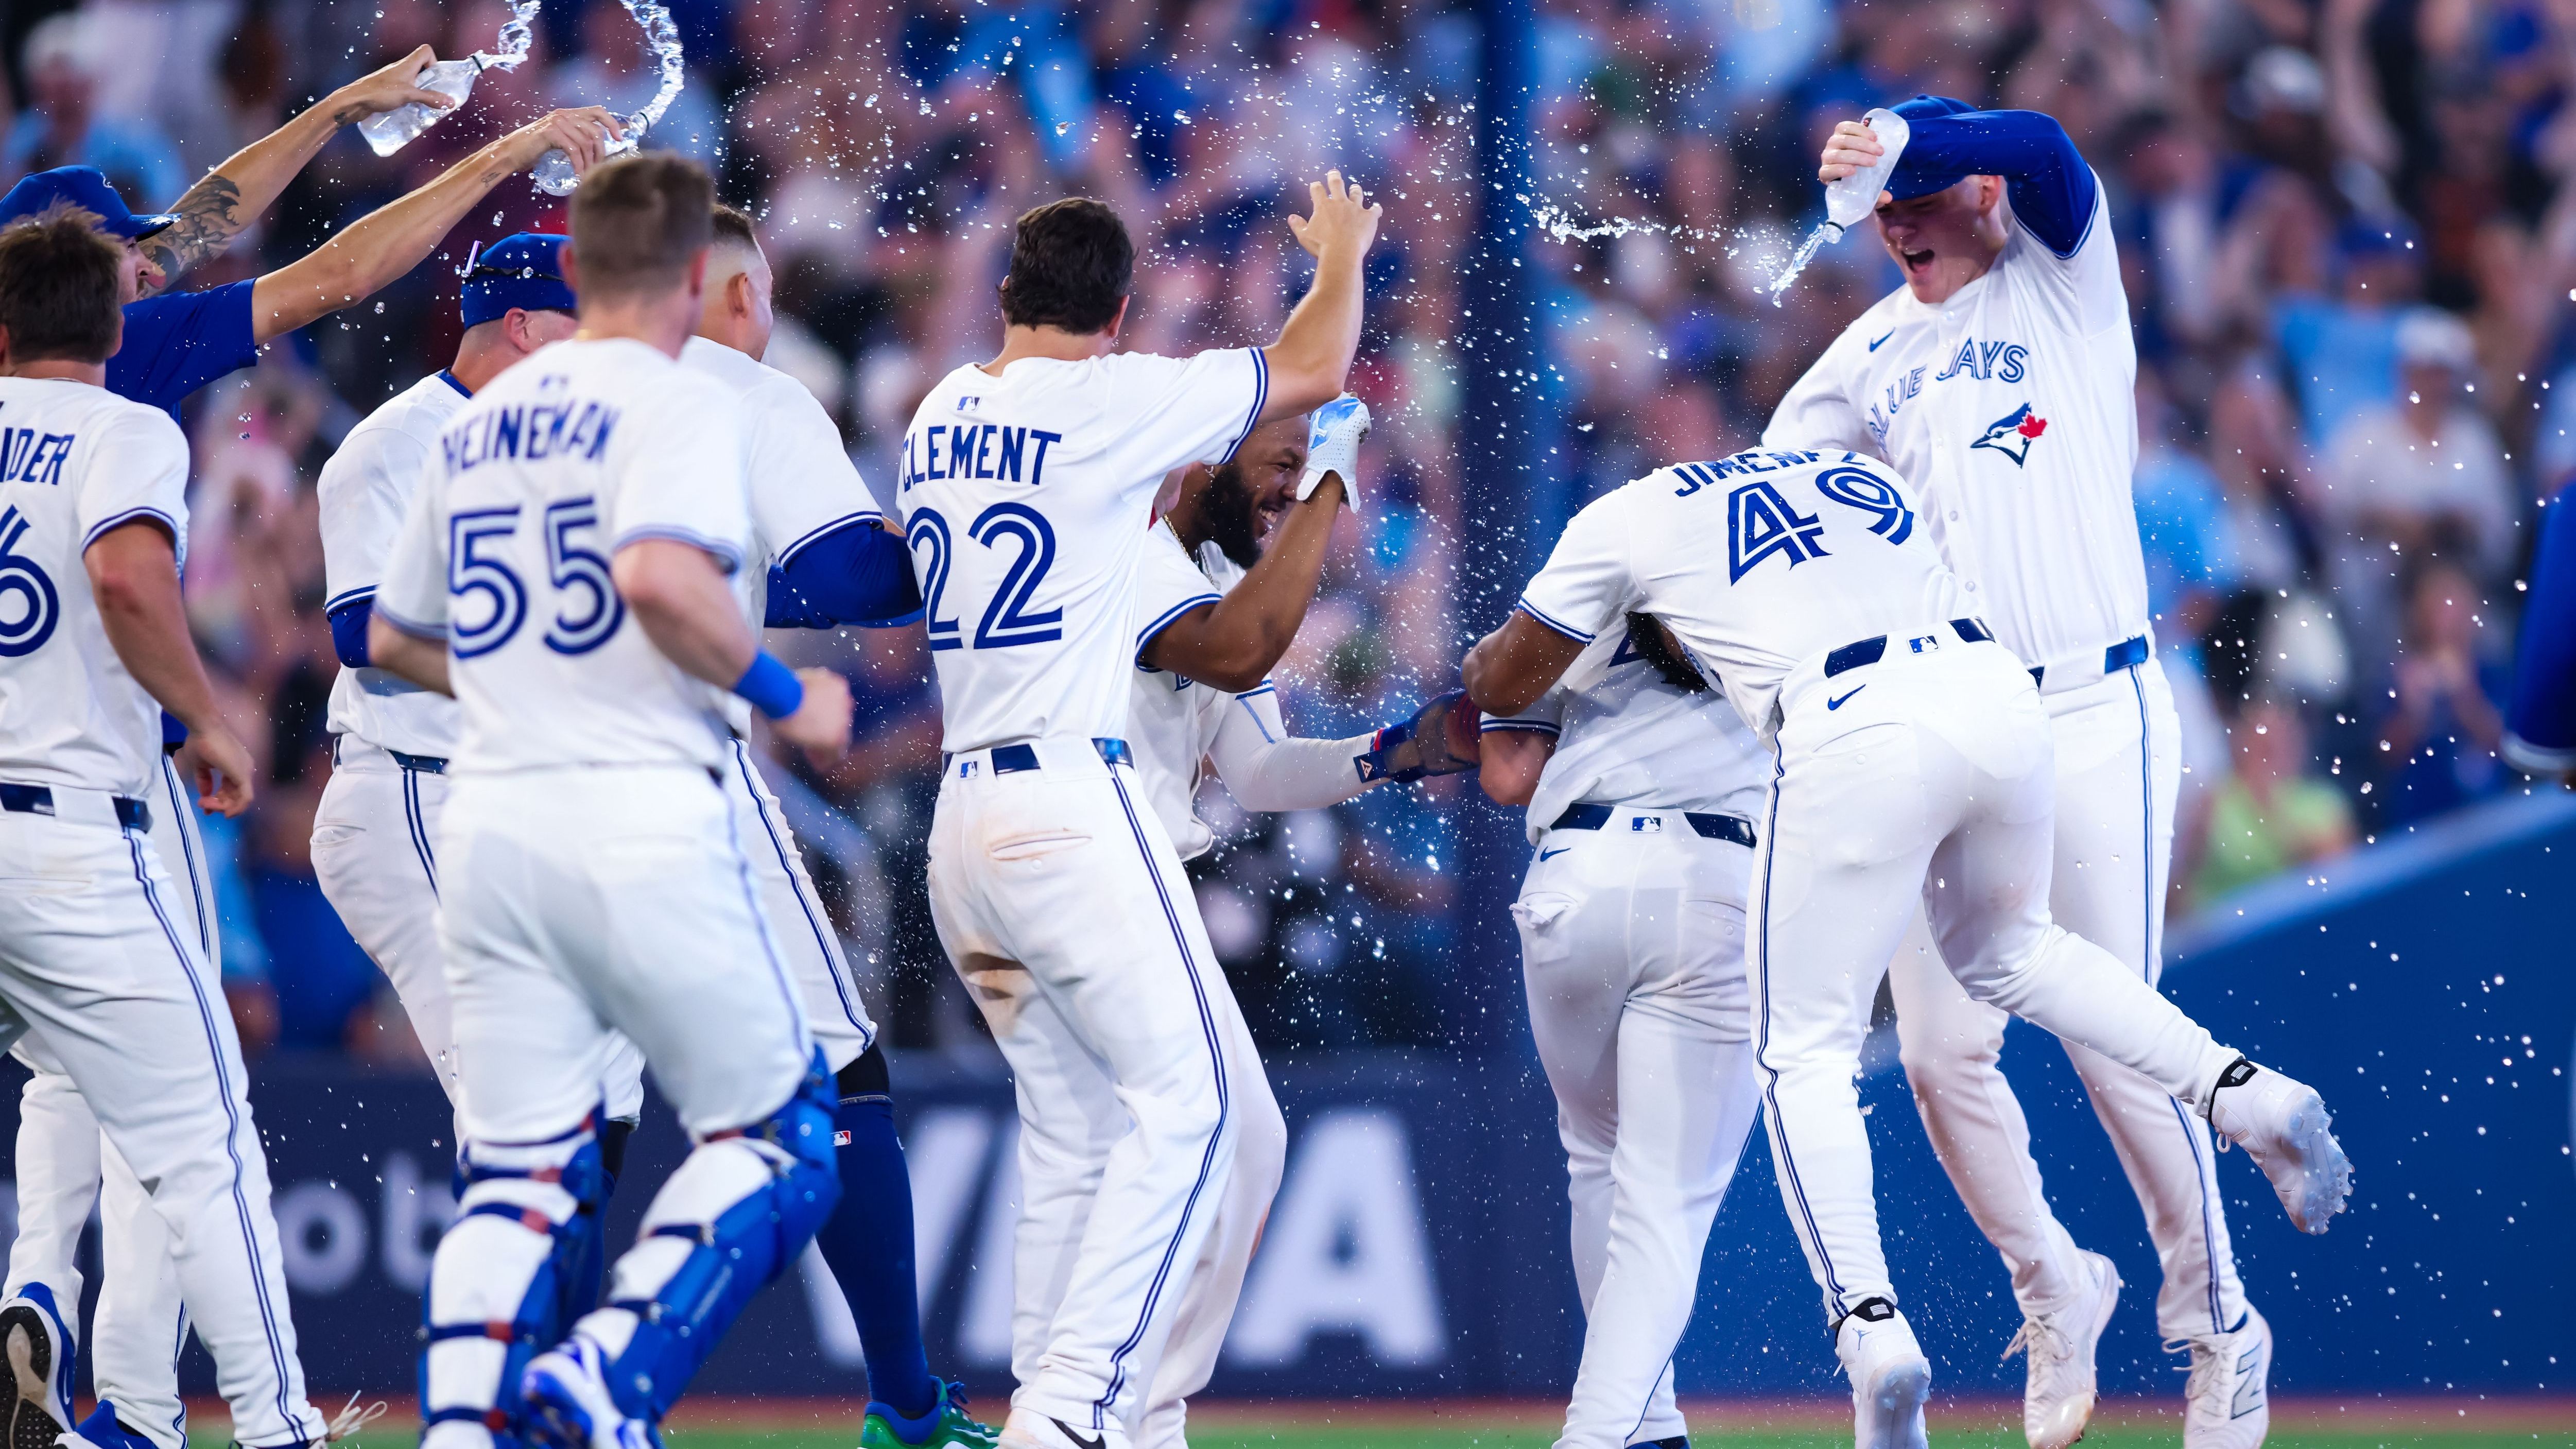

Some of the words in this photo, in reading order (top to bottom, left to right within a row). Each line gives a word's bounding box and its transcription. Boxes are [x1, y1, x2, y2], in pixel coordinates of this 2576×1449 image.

[1935, 336, 2029, 384] JAYS
[902, 425, 1062, 492] CLEMENT
[448, 494, 626, 660] 55
[905, 501, 1063, 651] 22
[1727, 466, 1914, 586] 49
